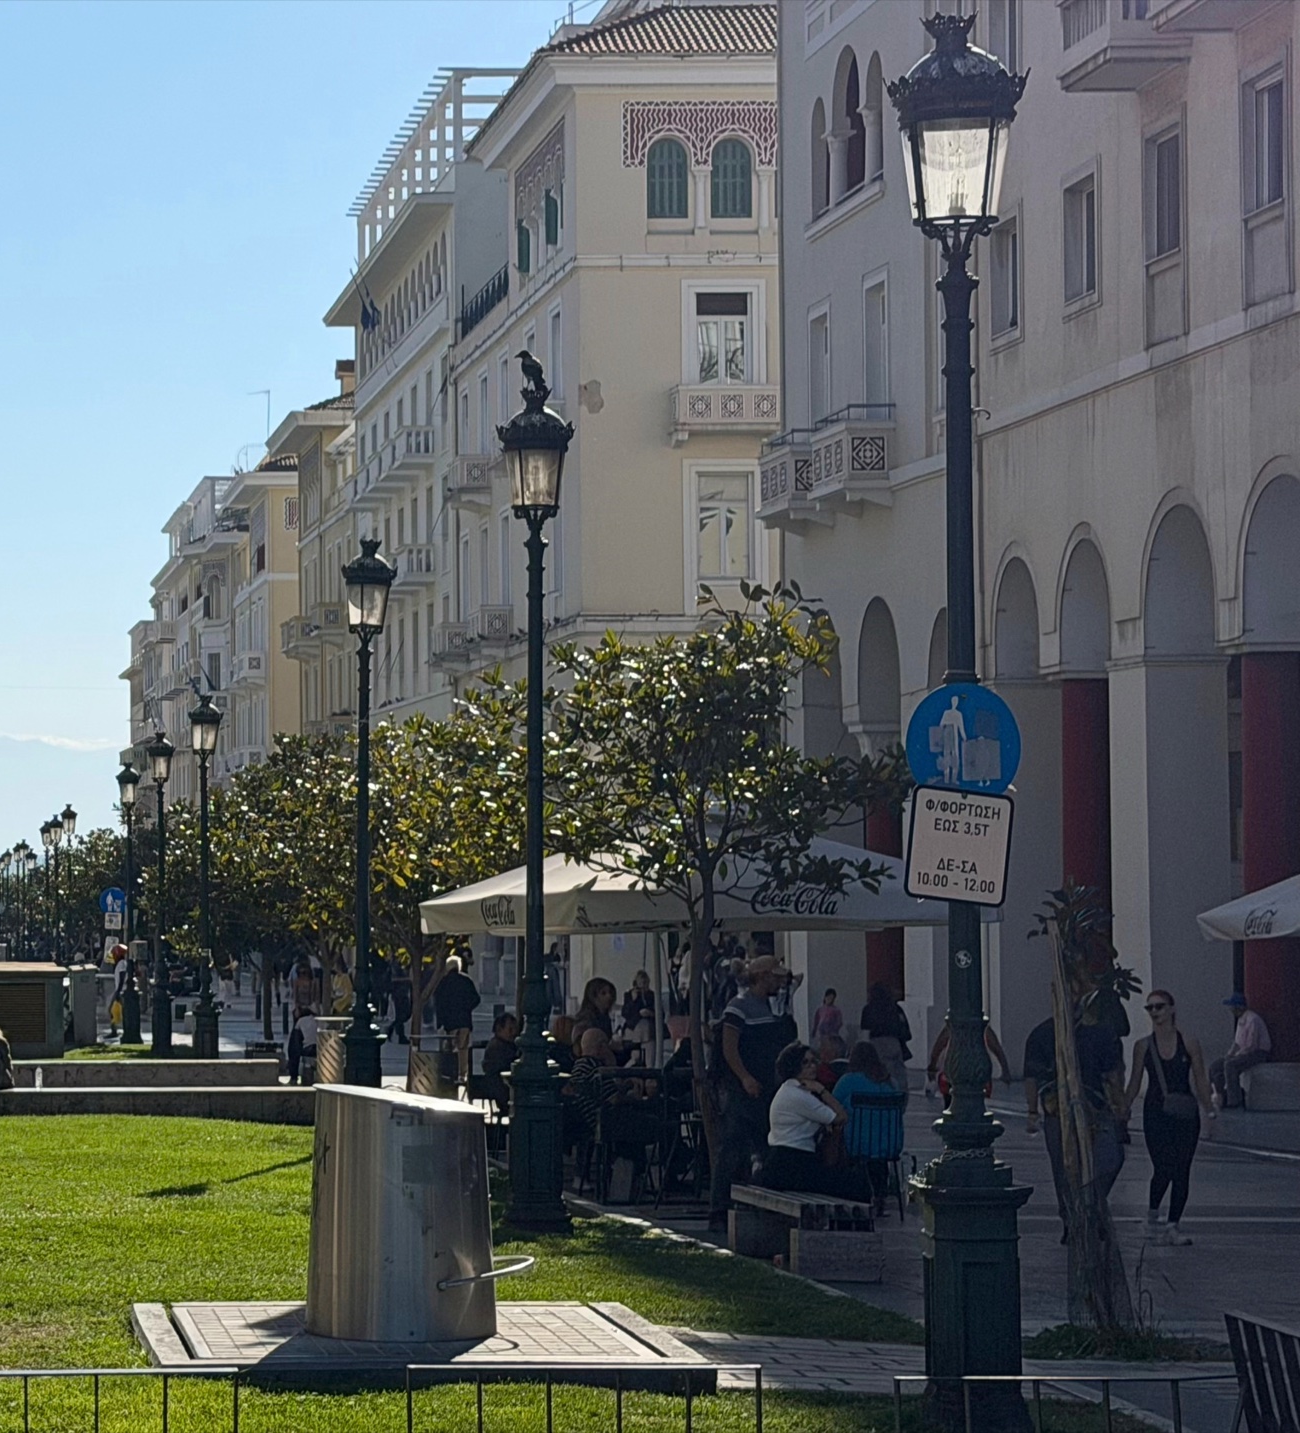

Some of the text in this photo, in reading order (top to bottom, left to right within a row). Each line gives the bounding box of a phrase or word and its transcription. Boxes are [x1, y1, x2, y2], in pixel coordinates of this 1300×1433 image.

[925, 798, 1001, 821] Φ/ΦΟΡΤΩΣΗ
[934, 817, 960, 833] ΕΩΣ
[936, 857, 978, 875] ΔΕ-ΣΑ
[917, 871, 949, 888] 10:00
[964, 877, 996, 894] 12:00
